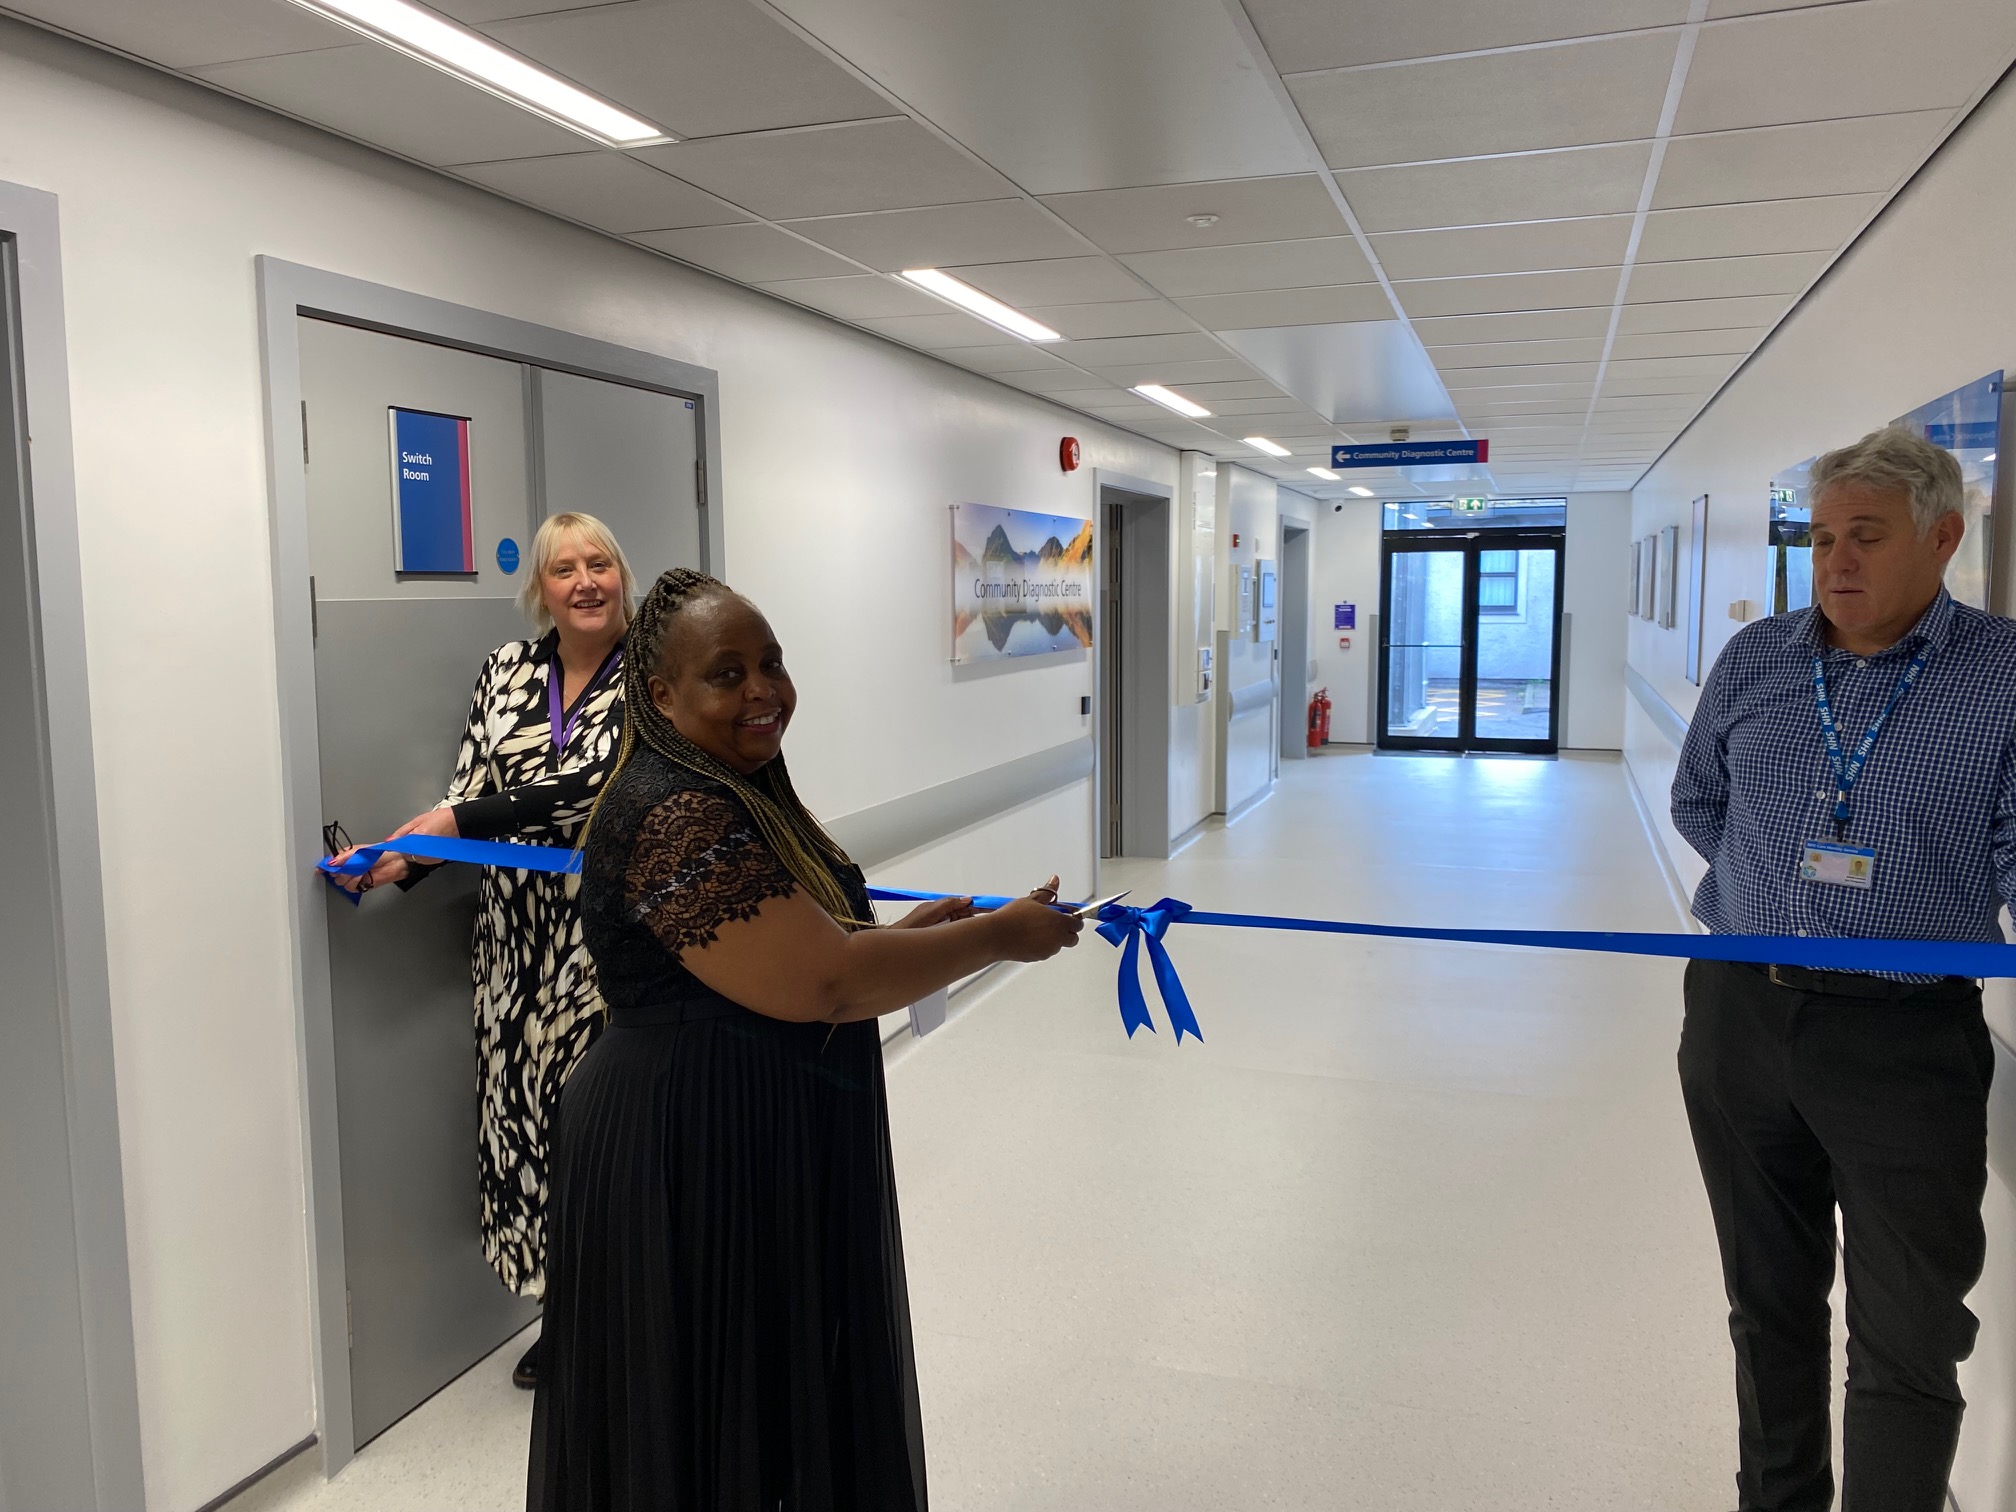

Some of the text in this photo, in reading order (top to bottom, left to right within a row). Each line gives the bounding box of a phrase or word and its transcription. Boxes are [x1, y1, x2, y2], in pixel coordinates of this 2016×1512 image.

[402, 451, 432, 466] Switch
[1353, 448, 1474, 460] Community Diagnostic Centre
[403, 468, 430, 481] Room
[974, 578, 1081, 603] Community Diagnostic Centre
[1815, 661, 1844, 775] NHS NHS NHS NHS NHS
[1845, 641, 1934, 782] NHS NHS NHS NHS NHS
